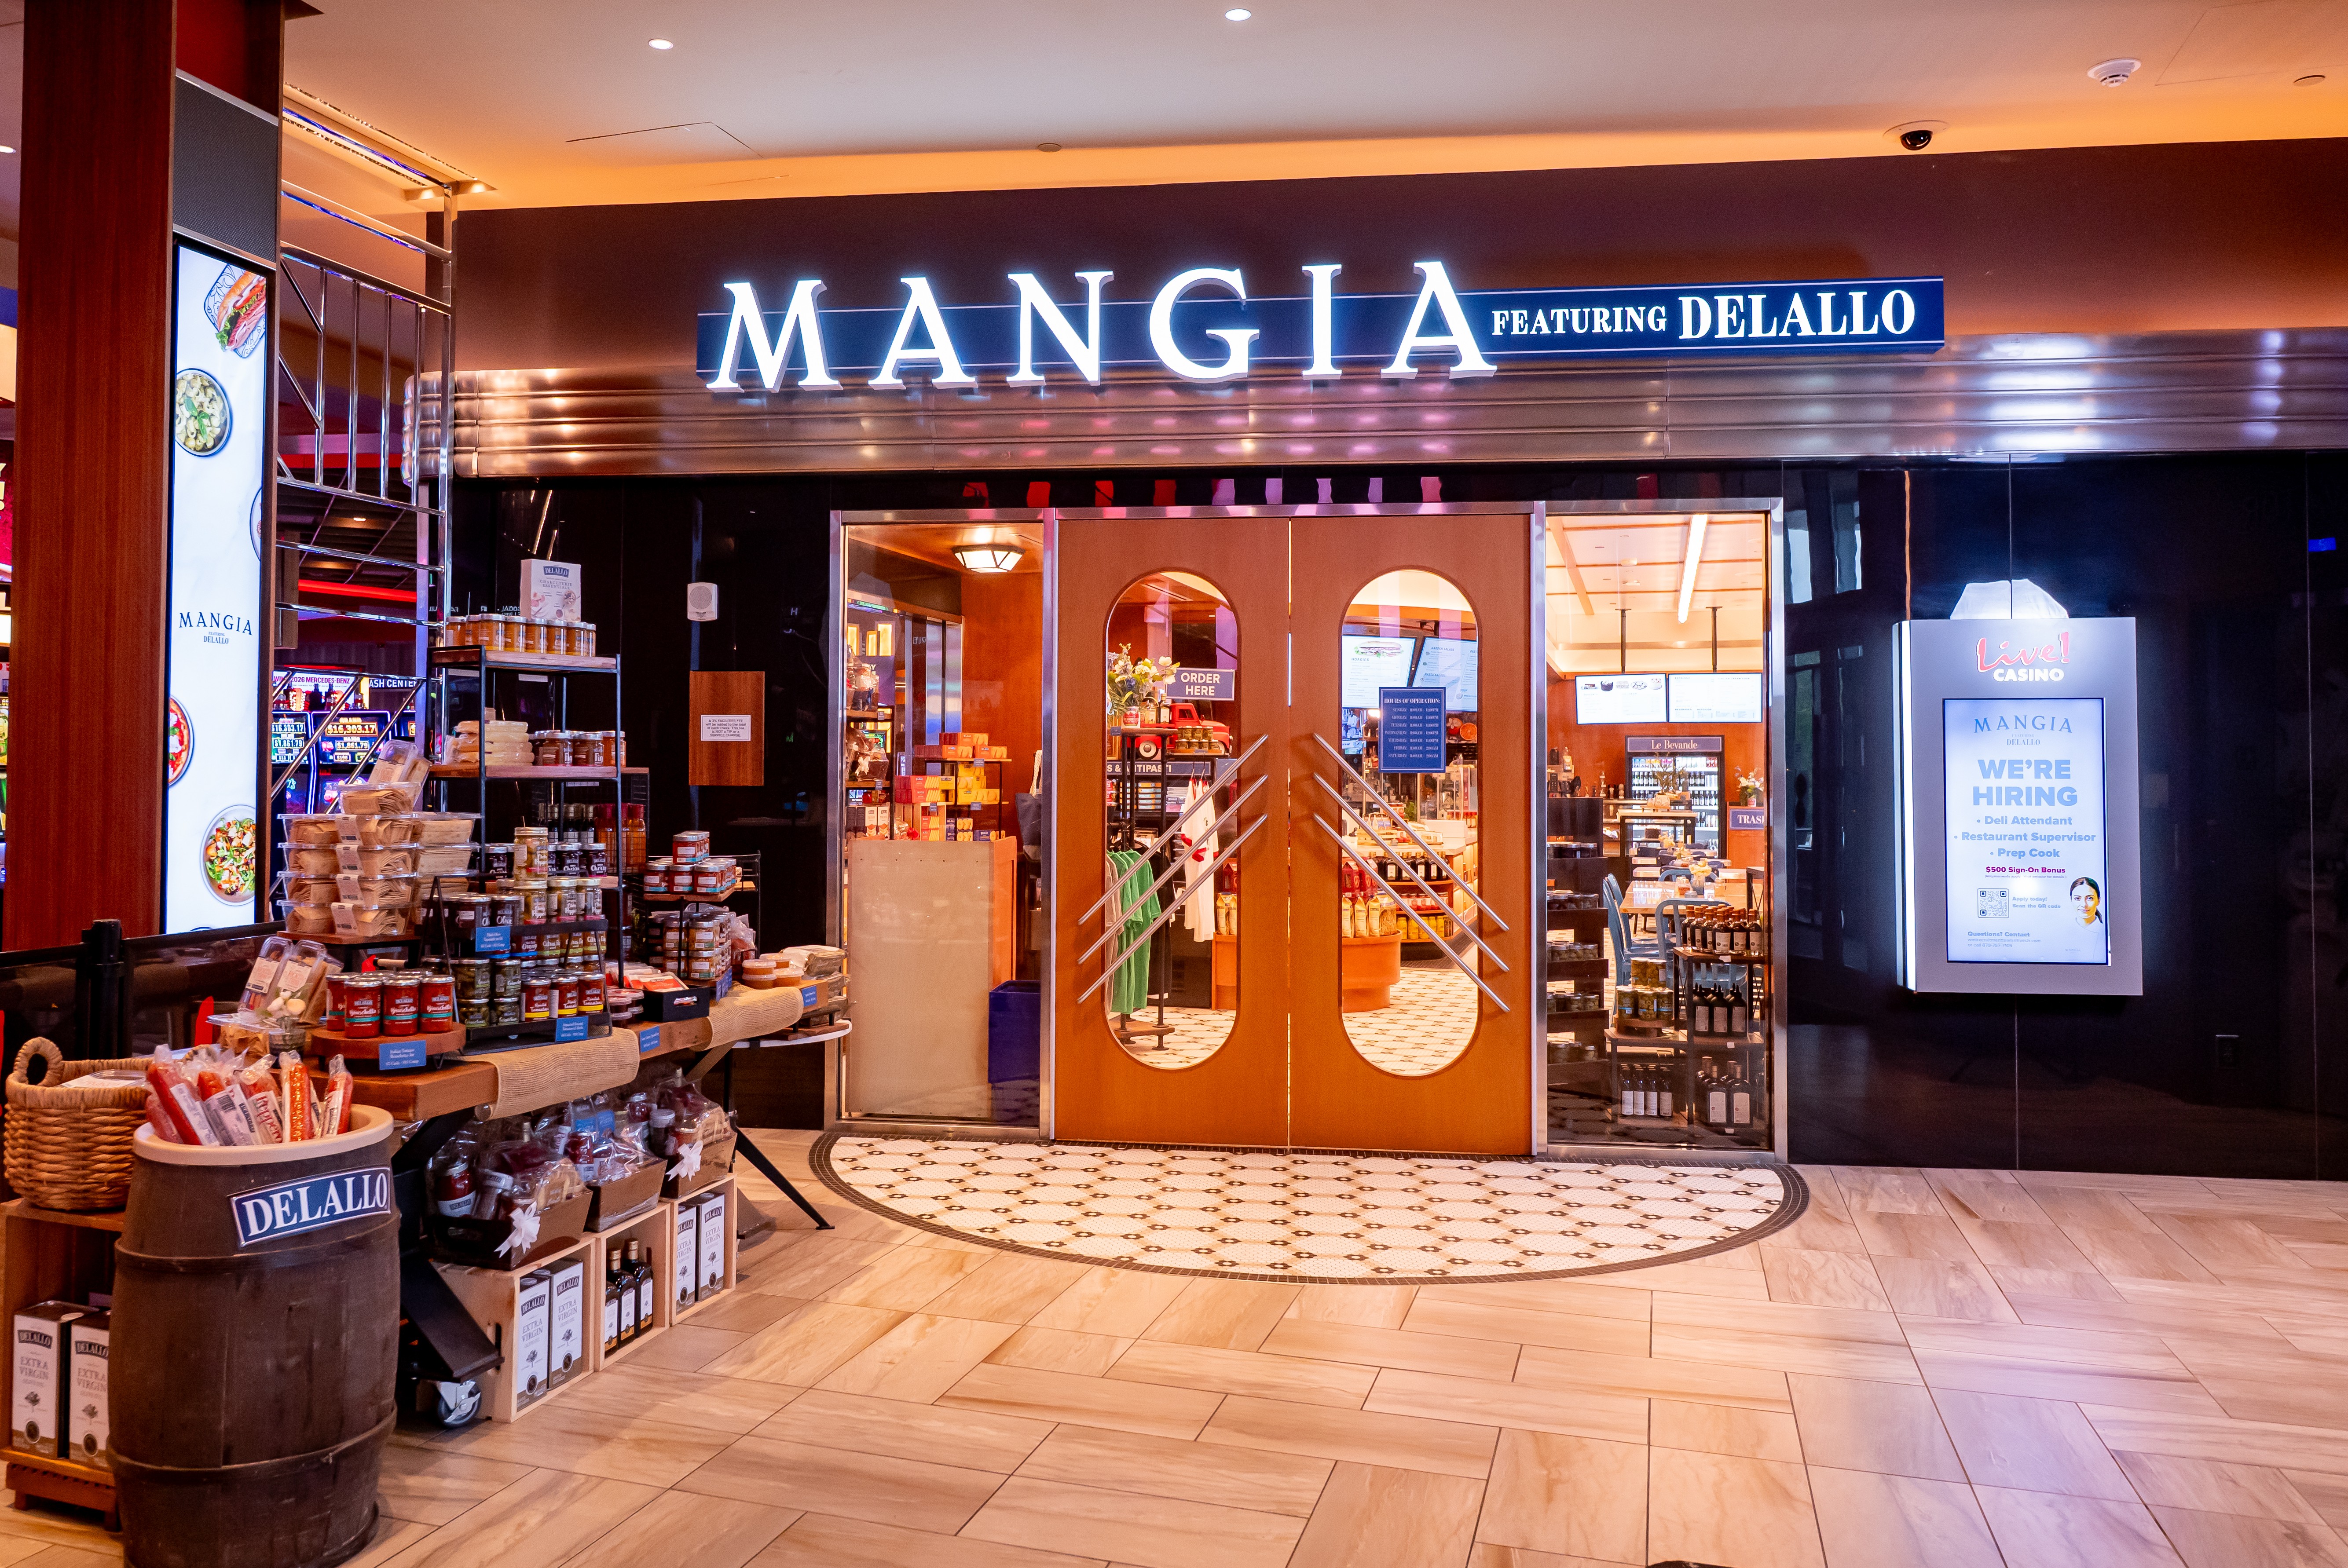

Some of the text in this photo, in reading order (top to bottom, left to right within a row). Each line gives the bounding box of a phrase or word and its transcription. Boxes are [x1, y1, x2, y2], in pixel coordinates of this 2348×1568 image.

[1491, 289, 1916, 340] FEATURING DELALLO
[706, 260, 1497, 393] MANGIA
[545, 567, 568, 576] DELALLO
[179, 612, 253, 635] MANGIA
[204, 636, 229, 644] DELALLO
[1976, 632, 2070, 672] Live!
[1180, 672, 1220, 683] ORDER
[1993, 668, 2064, 682] CASINO
[369, 679, 385, 687] ASH
[1186, 685, 1215, 696] HERE
[1974, 715, 2072, 733] MANGIA
[1652, 739, 1698, 749] Le Bevande
[1973, 786, 2077, 806] HIRING
[1985, 816, 2073, 825] Deli Attendant
[1962, 832, 2096, 843] Restaurant Supervisor
[1998, 848, 2060, 859] Prep Cook
[242, 1173, 388, 1236] DELALLO
[706, 1207, 722, 1221] DELALLO
[678, 1220, 693, 1232] ELALLO
[706, 1226, 720, 1238] EXTRA
[705, 1232, 721, 1244] VIRGIN
[558, 1277, 578, 1294] DELALLO
[522, 1296, 545, 1314] DELALLO
[559, 1298, 577, 1313] EXTRA
[558, 1306, 577, 1321] VIRGIN
[523, 1318, 542, 1334] EXTRA
[522, 1326, 543, 1342] VIRGIN
[20, 1356, 48, 1370] EXTRA
[19, 1367, 49, 1380] VIRGIN
[78, 1367, 106, 1382] EXTRA
